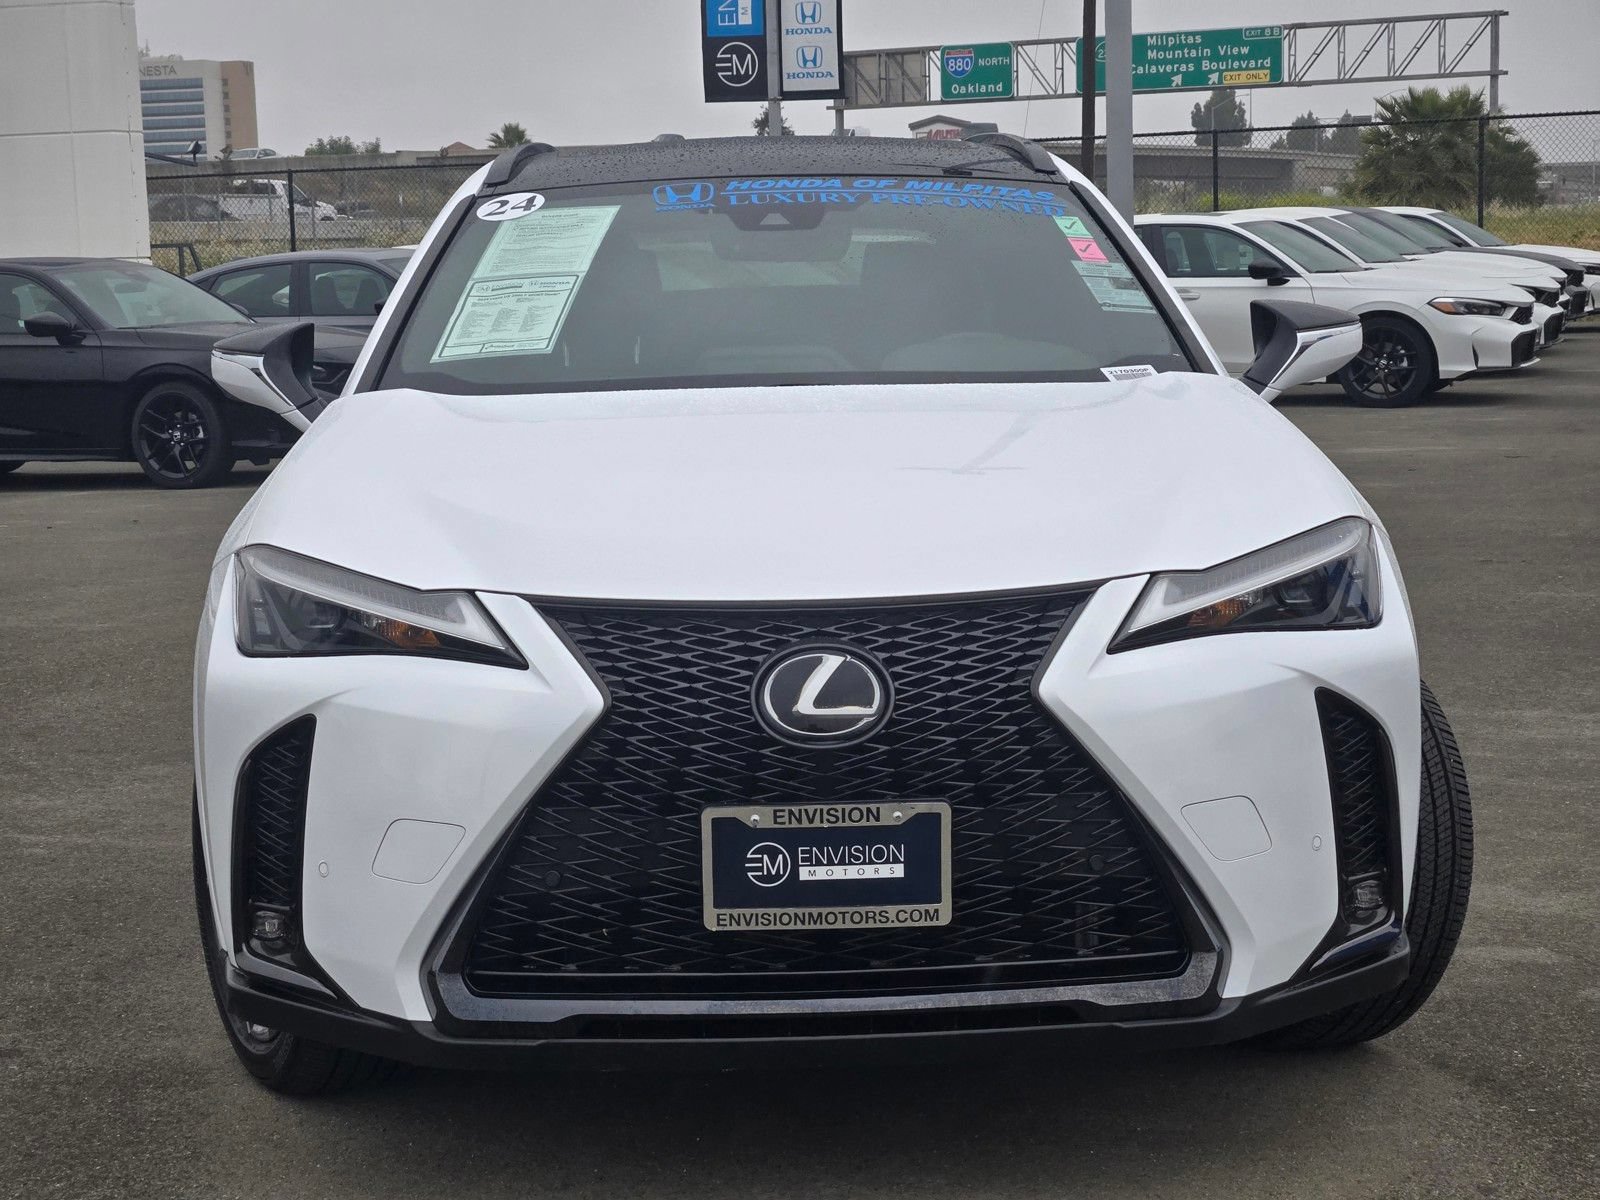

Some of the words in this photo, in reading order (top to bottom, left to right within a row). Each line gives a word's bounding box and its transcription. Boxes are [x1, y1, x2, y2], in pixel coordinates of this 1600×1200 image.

[785, 26, 833, 36] HONDA
[1245, 29, 1261, 37] EXIT
[1147, 34, 1202, 47] Milpitas
[1147, 46, 1211, 60] Mountain
[1218, 45, 1250, 56] View
[948, 58, 971, 72] 880
[978, 57, 1010, 67] NORTH
[1202, 57, 1271, 71] Boulevard
[786, 71, 834, 80] HONDA
[1224, 74, 1242, 82] EXIT
[951, 82, 1003, 94] Oakland
[726, 179, 842, 191] HONDA
[853, 179, 898, 188] OF
[905, 180, 1055, 200] MILPITAS
[730, 191, 863, 205] LUXURY
[482, 195, 538, 217] 24
[655, 203, 718, 212] HONDA
[772, 806, 882, 826] ENVISION
[798, 844, 905, 866] ENVISION
[808, 866, 896, 878] MOTORS
[716, 907, 941, 928] ENVISIONMOTORS.COM
